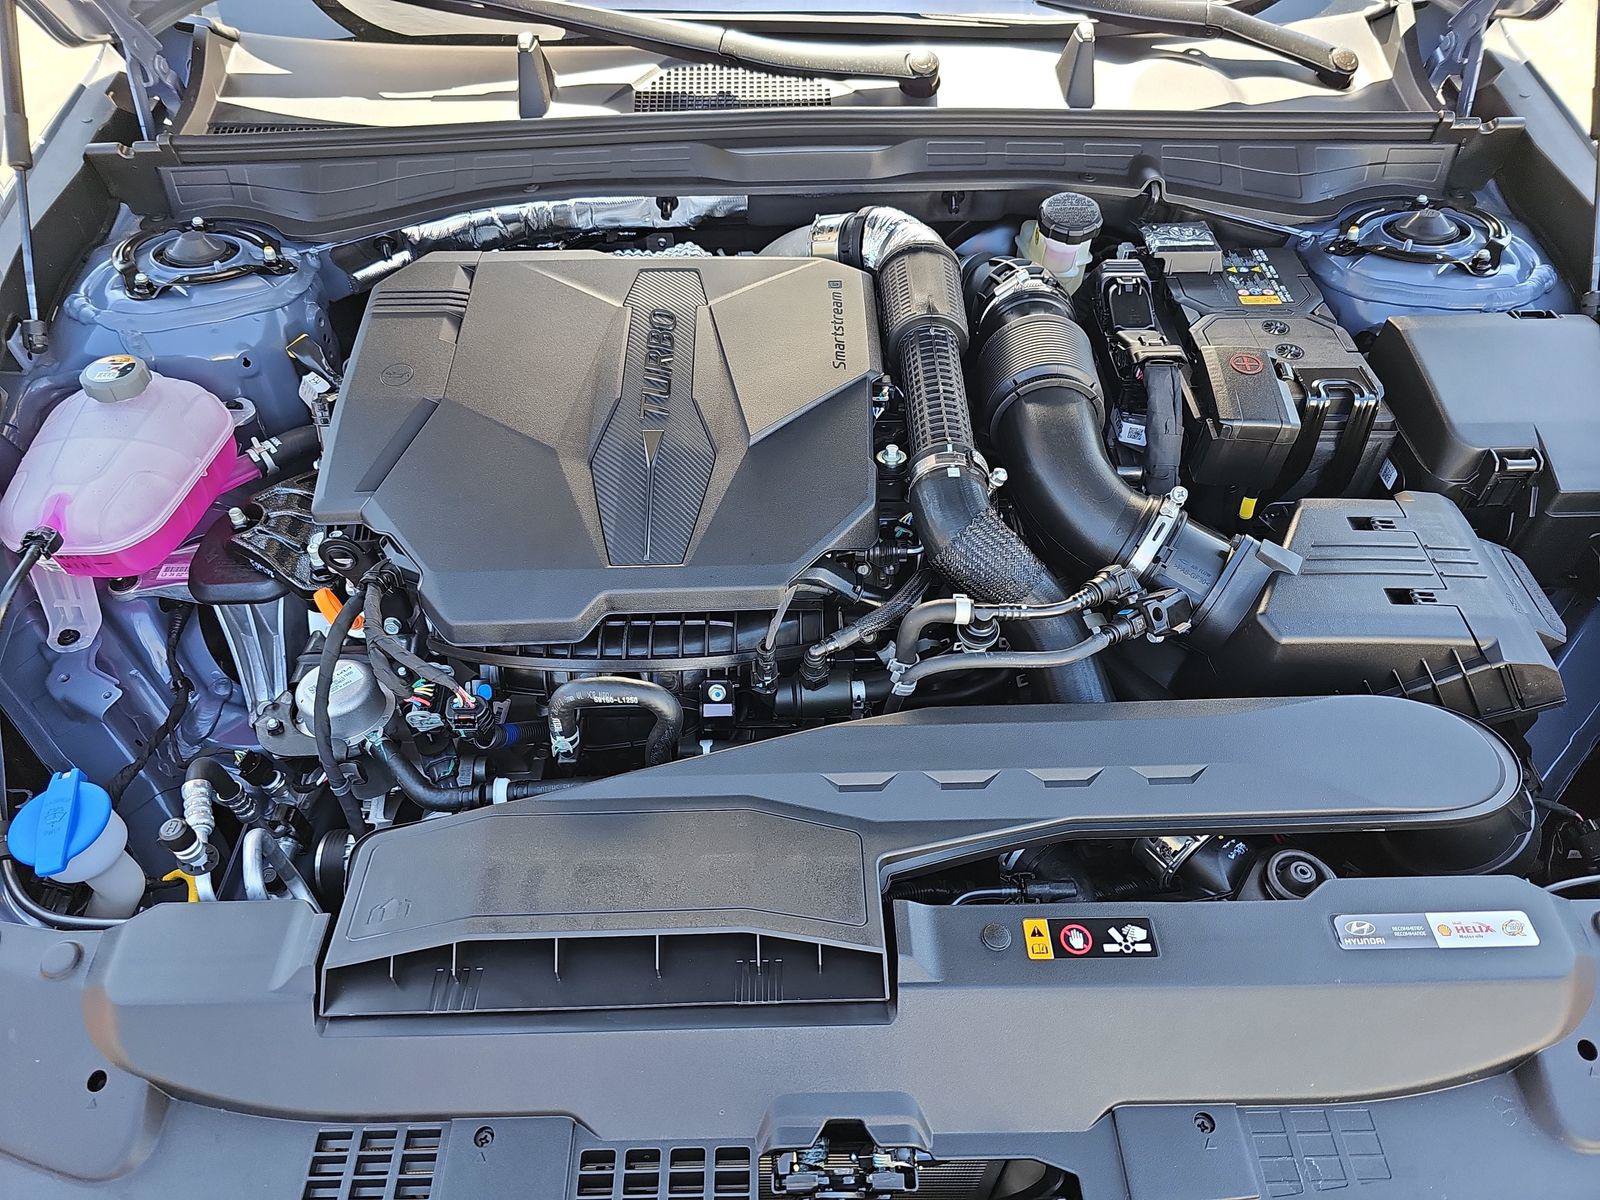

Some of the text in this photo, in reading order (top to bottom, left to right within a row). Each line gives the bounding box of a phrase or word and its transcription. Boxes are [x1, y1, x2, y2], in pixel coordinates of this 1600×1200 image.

[831, 291, 846, 370] Smartstream
[639, 308, 677, 419] TURBO
[1344, 937, 1386, 945] HYUNDAI
[1455, 924, 1494, 934] HELIX
